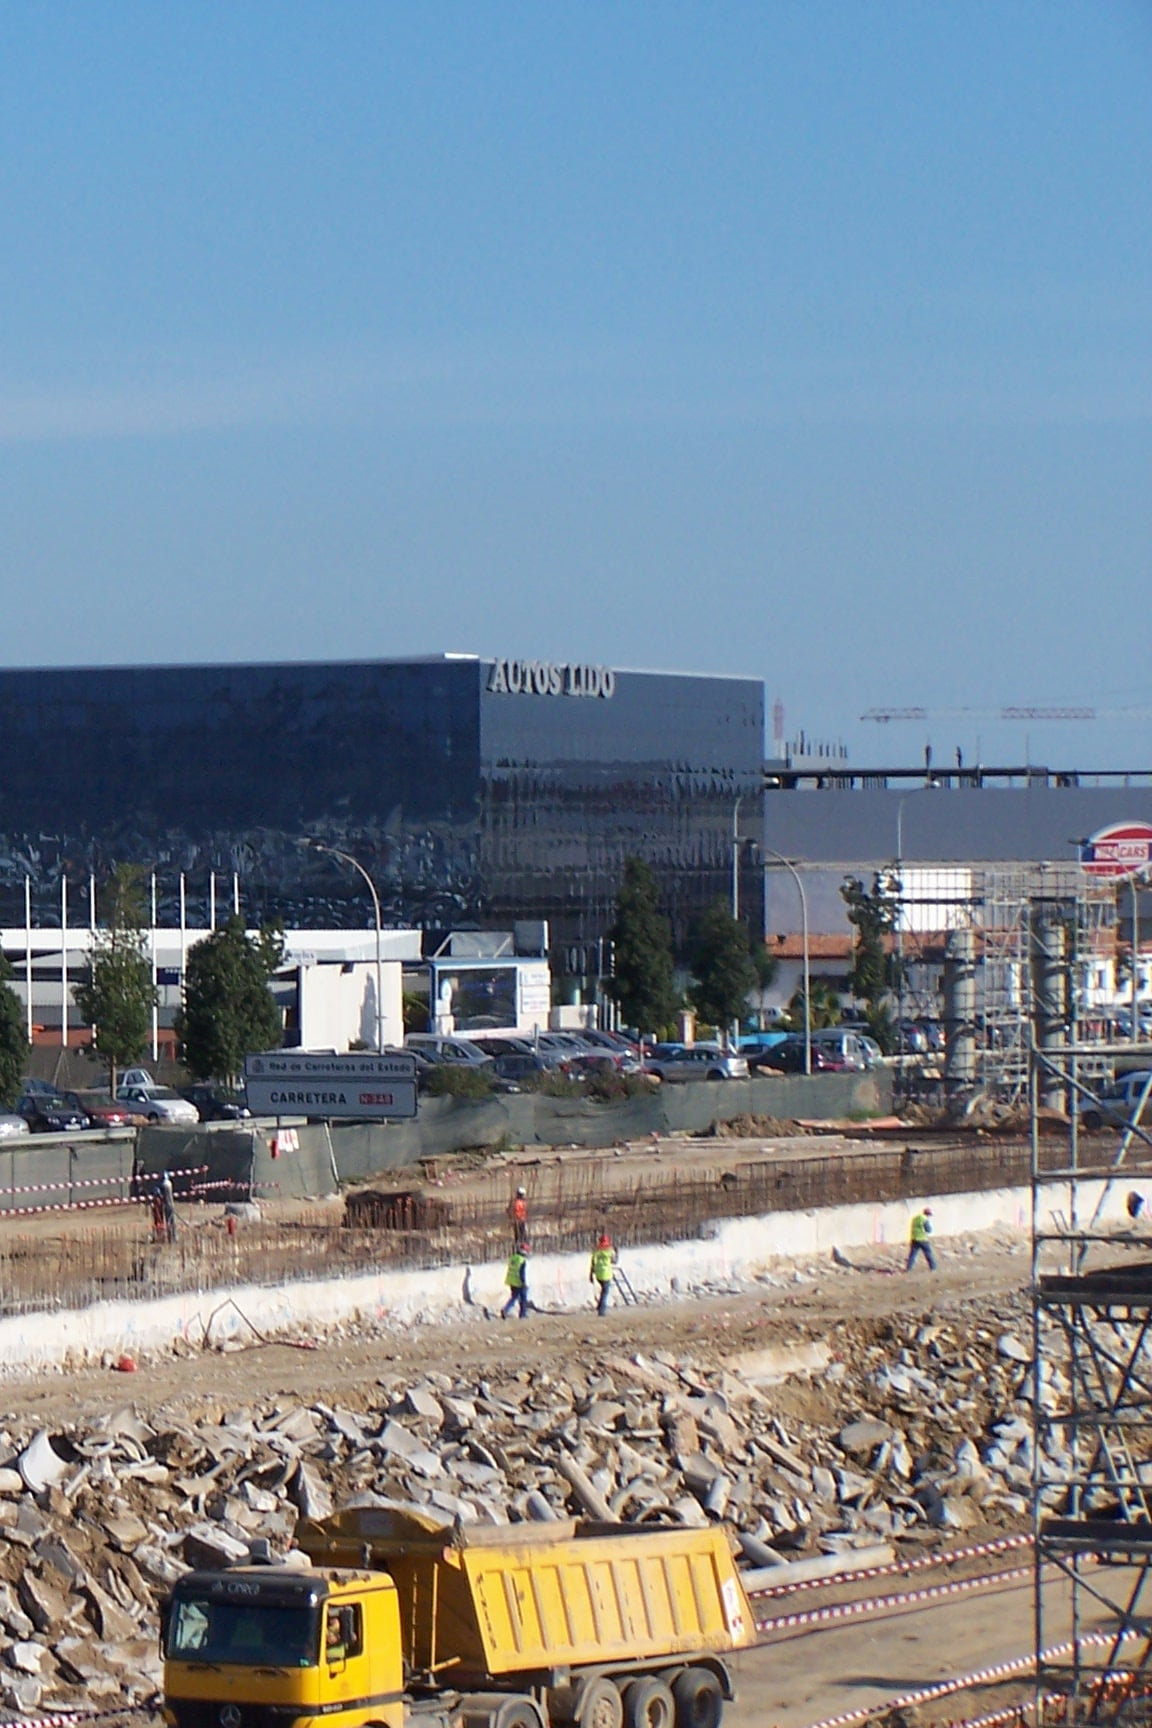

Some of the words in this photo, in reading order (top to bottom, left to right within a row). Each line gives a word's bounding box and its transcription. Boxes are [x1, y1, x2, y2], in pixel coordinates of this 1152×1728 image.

[486, 658, 566, 696] AUTOS
[567, 663, 615, 699] LIDO
[268, 1061, 287, 1072] Red
[359, 1061, 375, 1073] del
[377, 1061, 411, 1073] Estado
[270, 1091, 347, 1105] CARRETERA
